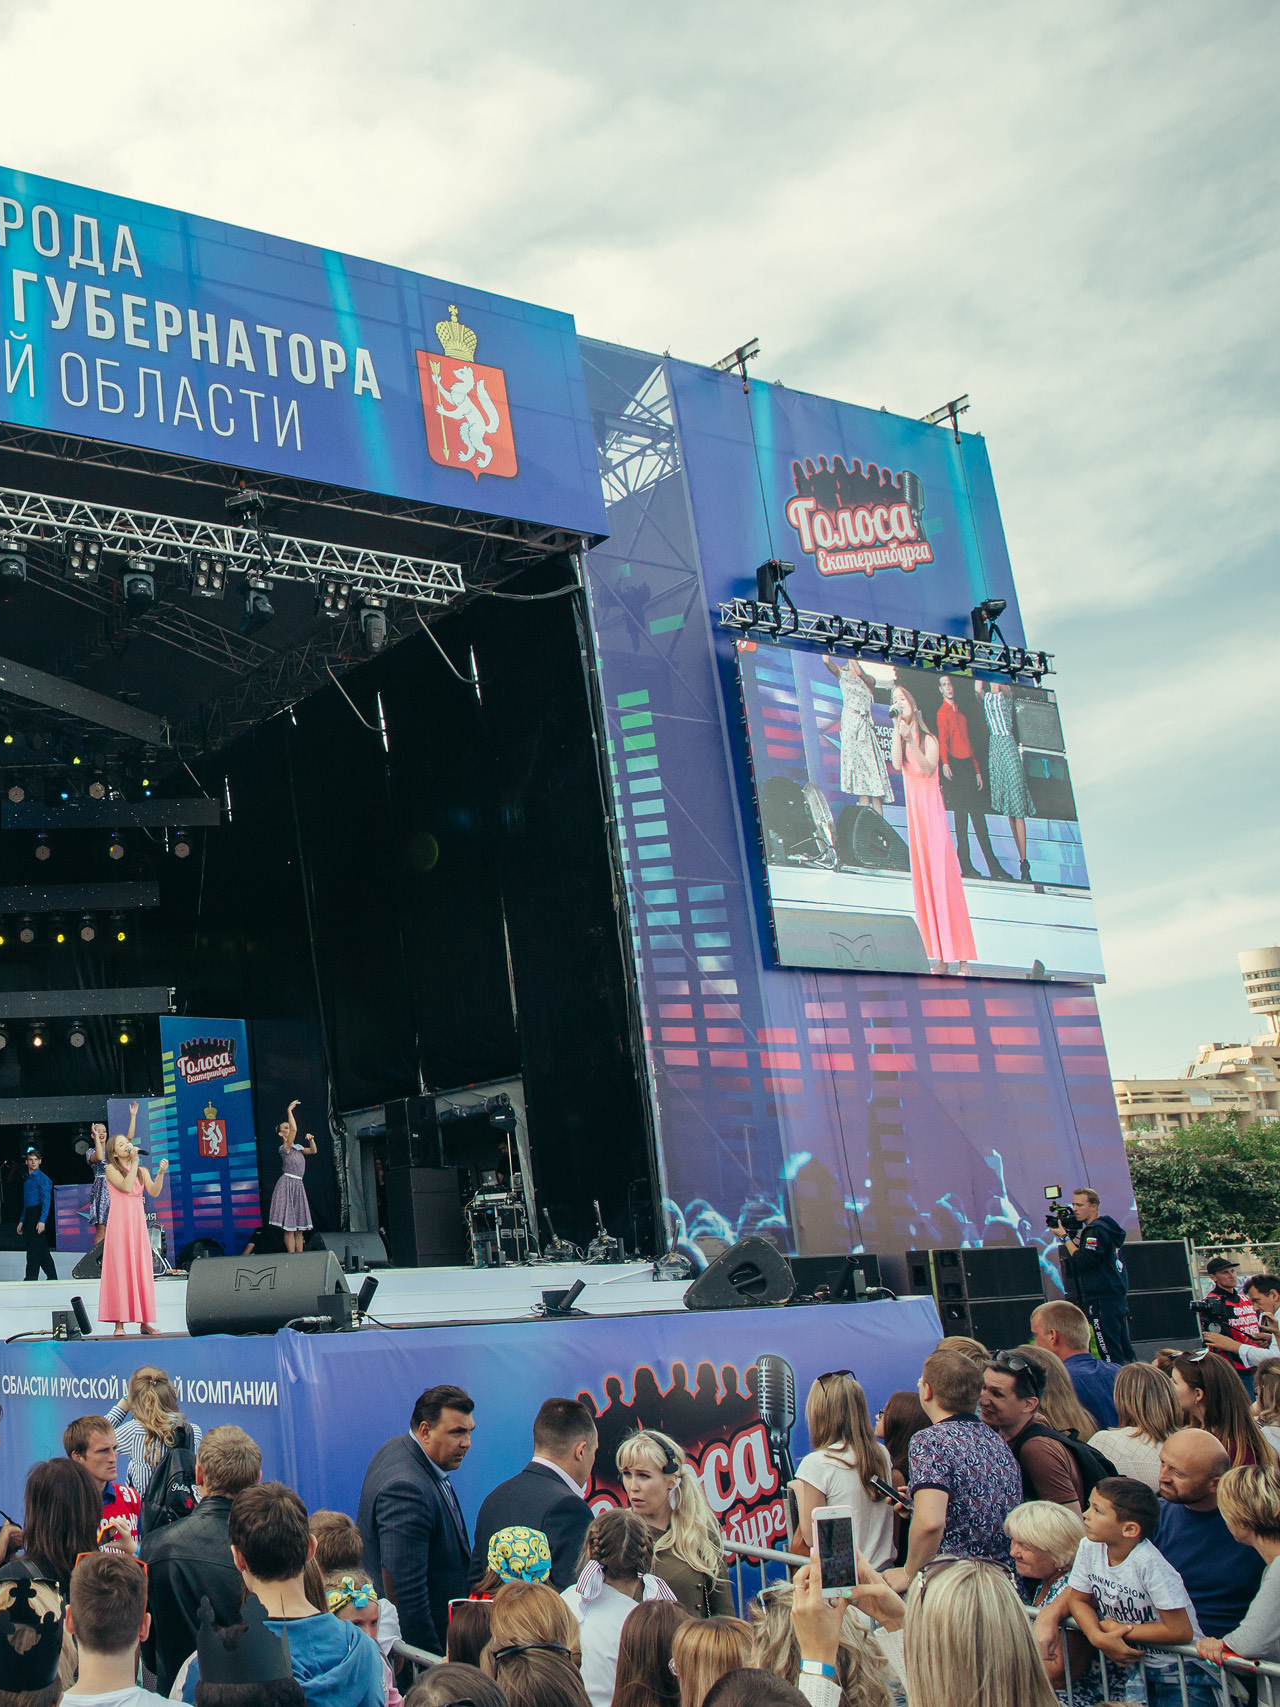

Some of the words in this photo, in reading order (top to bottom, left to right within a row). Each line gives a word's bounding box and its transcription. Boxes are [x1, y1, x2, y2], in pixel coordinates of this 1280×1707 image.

[11, 268, 382, 400] ГУБЕРНАТОРА
[60, 351, 303, 451] ОБЛАСТИ
[789, 499, 916, 550] Голоса
[818, 542, 931, 573] Екатеринбурга
[177, 1052, 231, 1077] Голоса
[1, 1374, 49, 1397] ОБЛАСТИ
[51, 1377, 59, 1397] И
[60, 1374, 119, 1400] РУССКОЙ
[187, 1379, 278, 1406] КОМПАНИИ
